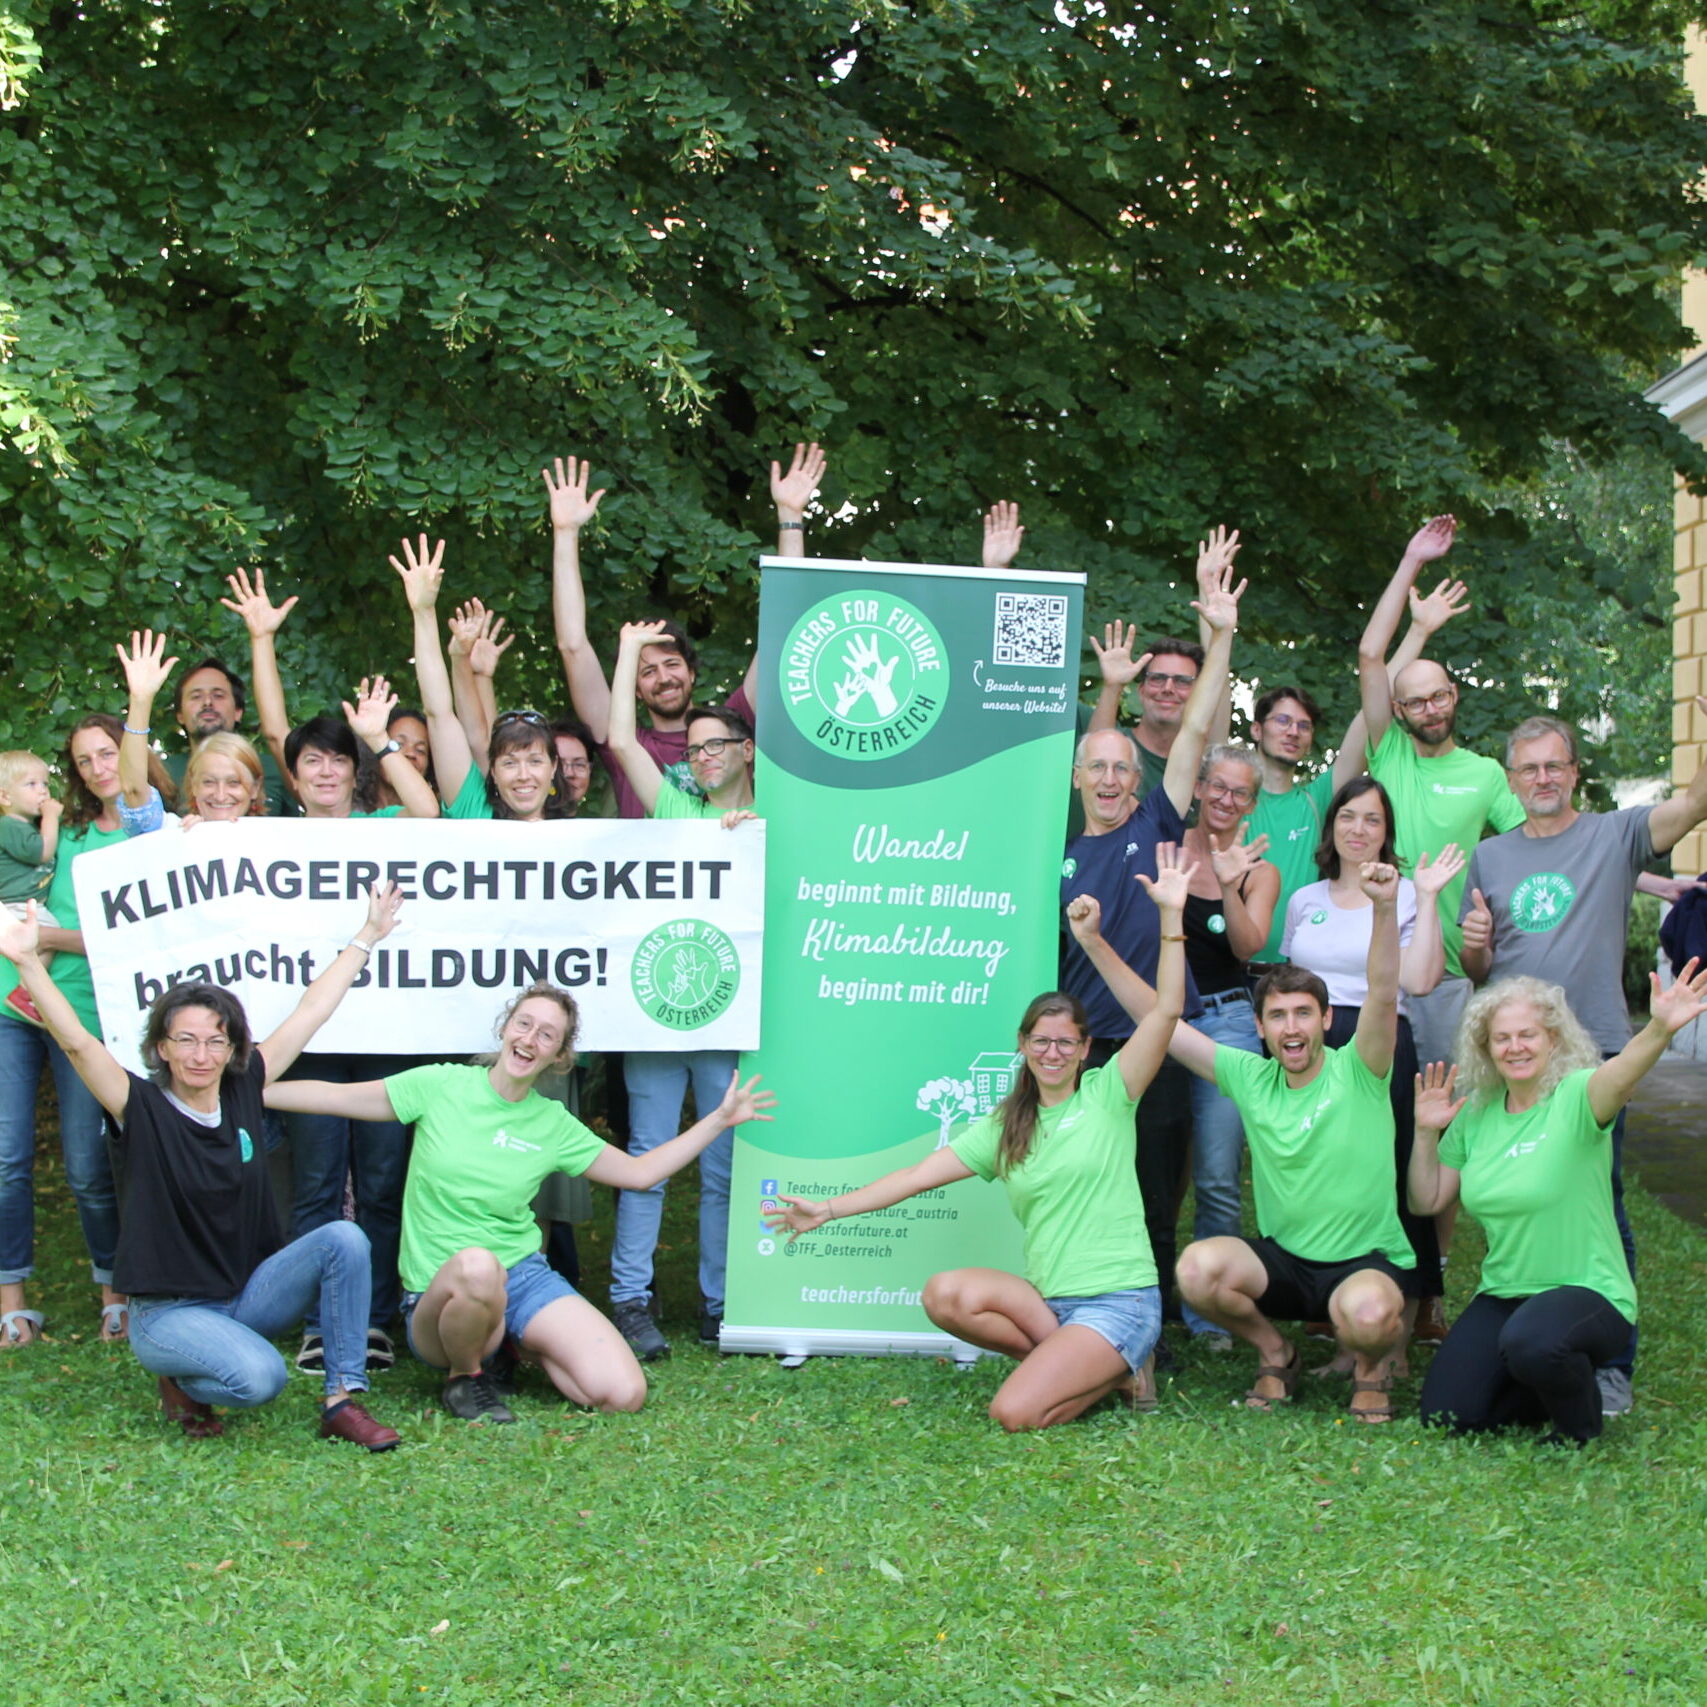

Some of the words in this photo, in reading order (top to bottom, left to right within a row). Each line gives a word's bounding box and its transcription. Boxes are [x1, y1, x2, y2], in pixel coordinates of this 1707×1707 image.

[788, 611, 836, 706] TEACHERS
[841, 600, 879, 624] FOR
[886, 607, 940, 673] FUTURE
[982, 702, 1022, 712] unserer
[1023, 700, 1067, 714] Website!
[984, 678, 1026, 693] Besuche
[1027, 685, 1046, 694] uns
[1048, 682, 1067, 700] auf
[816, 694, 936, 752] ÖSTERREICH
[853, 823, 969, 863] Wandel
[100, 857, 732, 930] KLIMAGERECHTIGKEIT
[797, 876, 882, 908] beginnt
[887, 883, 925, 906] mit
[930, 884, 1017, 916] Bildung,
[635, 933, 665, 1005] TEACHERS
[667, 922, 695, 939] FOR
[700, 927, 736, 973] FUTURE
[801, 918, 1010, 978] Klimabildung
[134, 943, 316, 1010] braucht
[818, 974, 903, 1006] beginnt
[908, 981, 946, 1003] mit
[951, 981, 990, 1005] dir!
[786, 1181, 838, 1196] Teachers
[801, 1285, 923, 1307] teachersforfut
